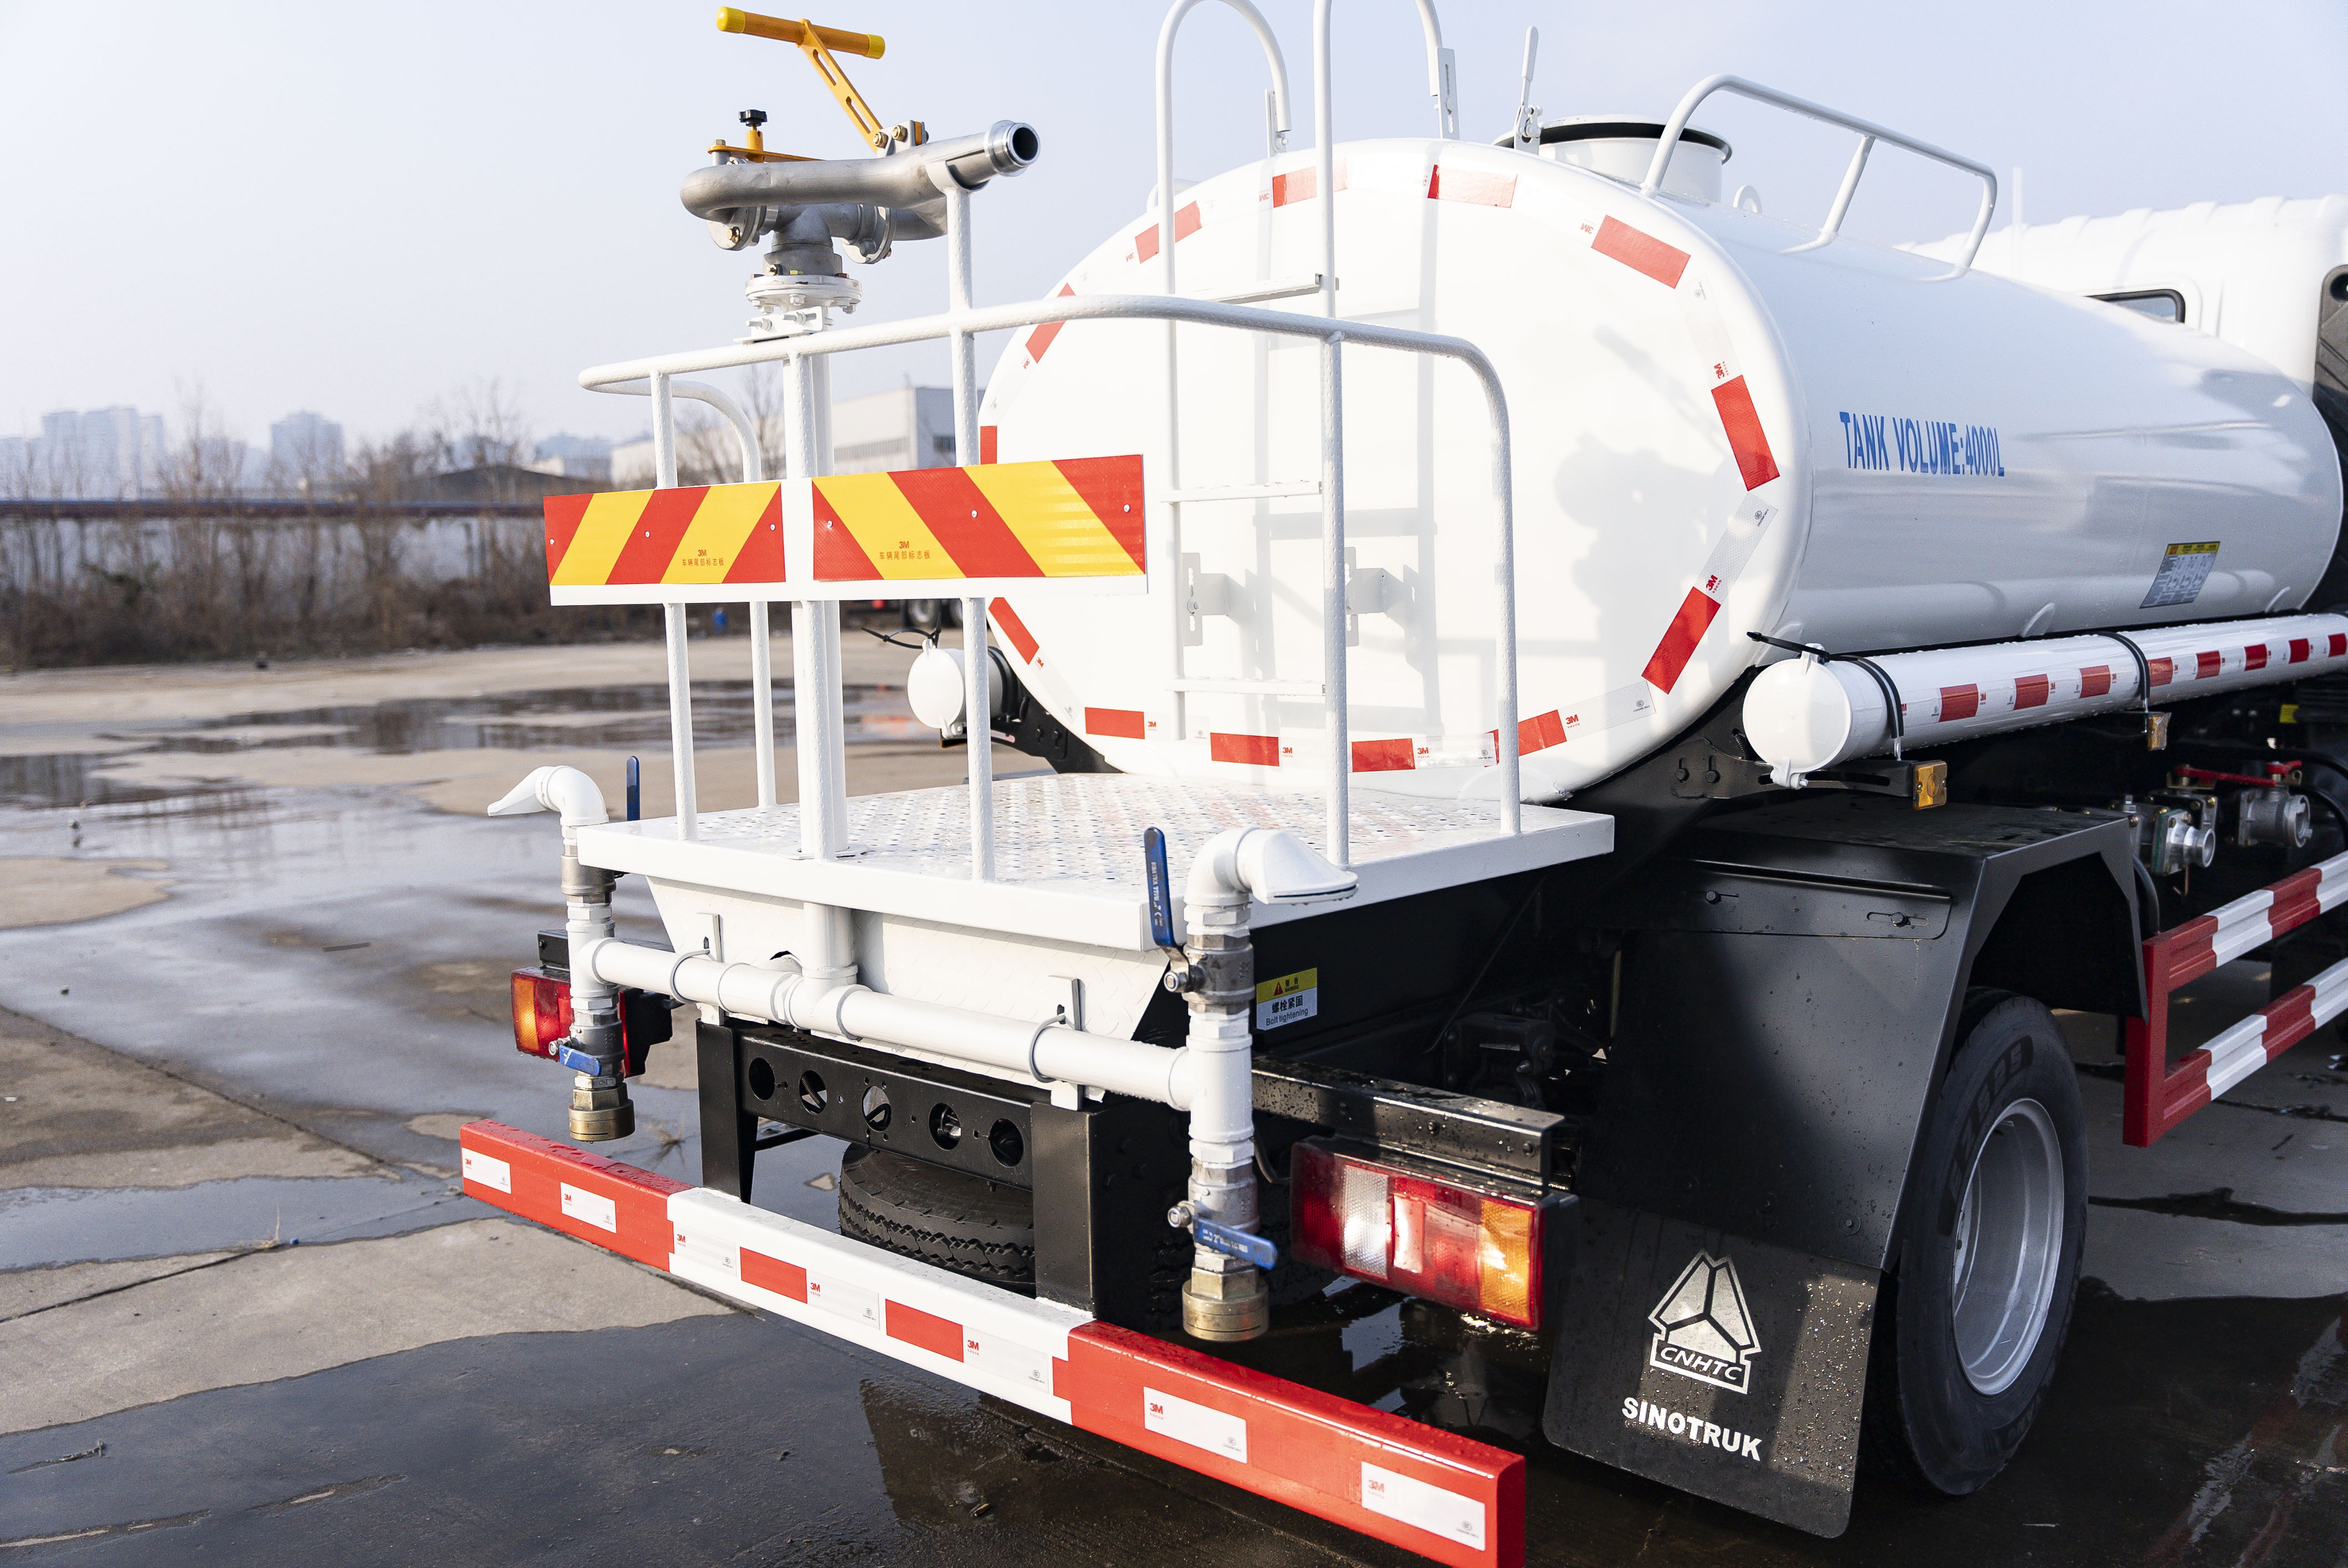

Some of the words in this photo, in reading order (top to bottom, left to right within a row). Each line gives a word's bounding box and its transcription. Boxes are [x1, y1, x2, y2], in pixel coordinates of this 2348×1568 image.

[1580, 223, 1594, 234] 3M
[1714, 363, 1725, 379] 3M
[1839, 411, 1890, 471] TANK
[1892, 416, 2005, 477] VOLUME:4000L
[899, 540, 910, 549] 3M
[697, 549, 707, 557] 3M
[1706, 575, 1718, 591] 3M
[1979, 692, 1986, 701] 3M
[1566, 714, 1579, 725] 3M
[1266, 1015, 1278, 1026] Bolt
[1279, 1008, 1309, 1023] tightening
[564, 1194, 571, 1202] 3M
[677, 1234, 686, 1243] 3M
[810, 1282, 820, 1293] 3M
[967, 1339, 979, 1351] 3M
[1660, 1345, 1743, 1381] CNHTC
[1150, 1402, 1163, 1415] 3M
[1621, 1396, 1763, 1462] SINOTRUK
[1368, 1479, 1384, 1493] 3M
